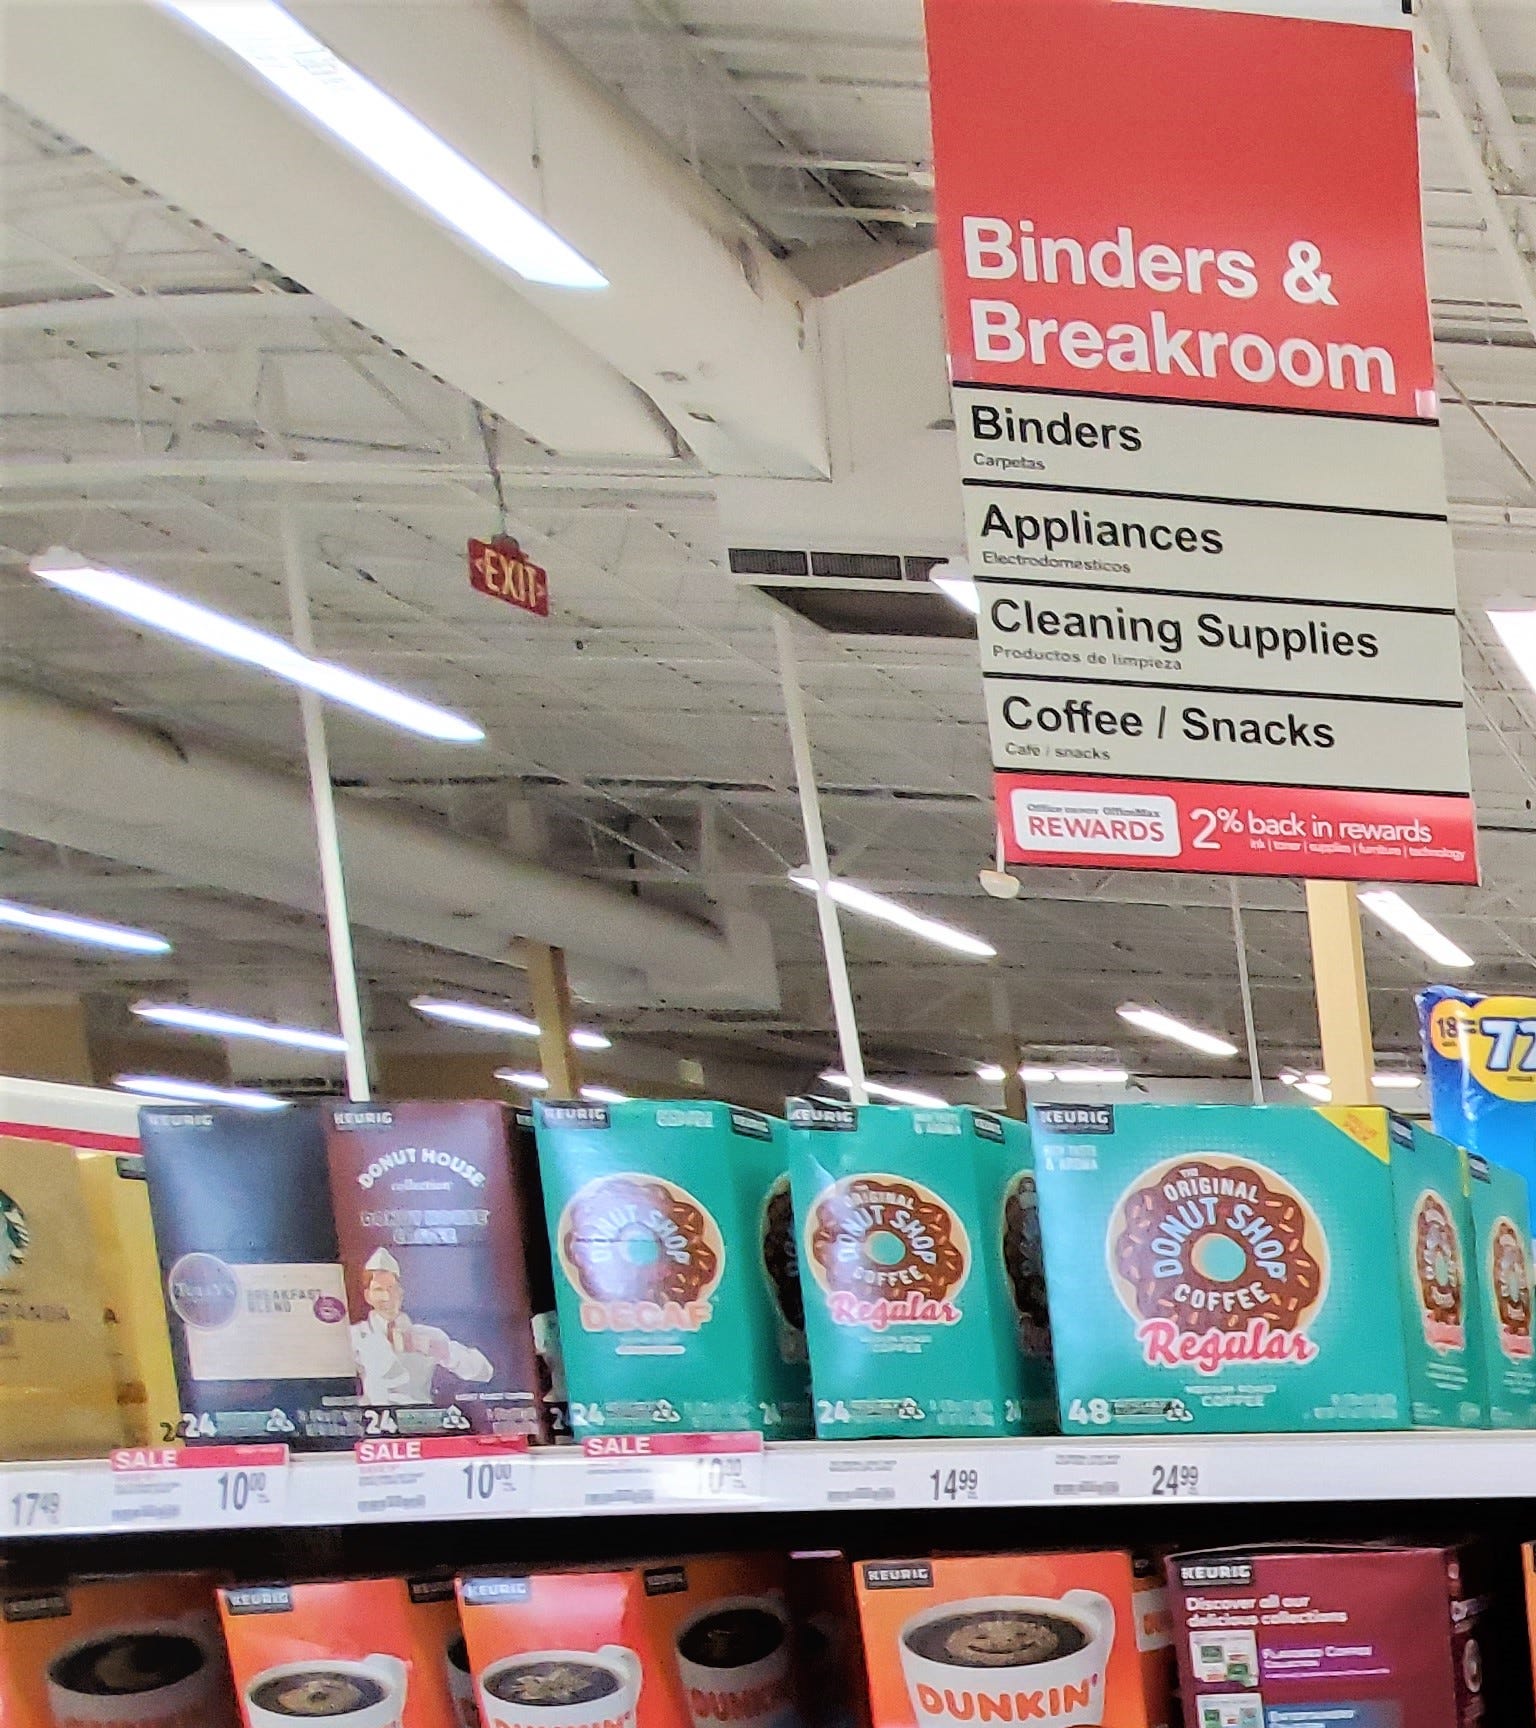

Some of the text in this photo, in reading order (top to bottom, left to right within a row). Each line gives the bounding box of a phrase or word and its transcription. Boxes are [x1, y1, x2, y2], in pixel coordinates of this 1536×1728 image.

[963, 216, 1339, 306] Binders &
[969, 298, 1397, 395] Breakroom
[971, 405, 1141, 453] Binders
[973, 453, 1045, 472] Carpetas
[980, 504, 1224, 555] Appliances
[484, 551, 539, 608] EXIT
[991, 599, 1379, 658] Cleaning Supplies
[993, 644, 1182, 671] Productos de limpieza
[1002, 695, 1335, 748] Coffee / Snacks
[1053, 744, 1110, 761] snacks
[1028, 816, 1165, 843] REWARDS
[1188, 805, 1244, 850] 2%
[1249, 809, 1306, 837] back
[1311, 814, 1333, 838] in
[1338, 819, 1433, 844] rewards
[1040, 1108, 1111, 1129] KEURIG
[356, 1147, 488, 1191] DONUT HOUSE
[1162, 1176, 1261, 1204] ORIGINAL
[891, 1210, 936, 1266] SHOP
[1151, 1196, 1288, 1281] DONUT SHOP
[852, 1265, 926, 1288] COFFEE
[831, 1294, 961, 1328] Regular
[1172, 1279, 1272, 1312] COFFEE
[580, 1299, 712, 1332] DECAF
[1137, 1320, 1320, 1376] Regular
[1068, 1399, 1112, 1425] 48
[116, 1448, 181, 1470] SALE
[358, 1439, 421, 1461] SALE
[587, 1434, 651, 1457] SALE
